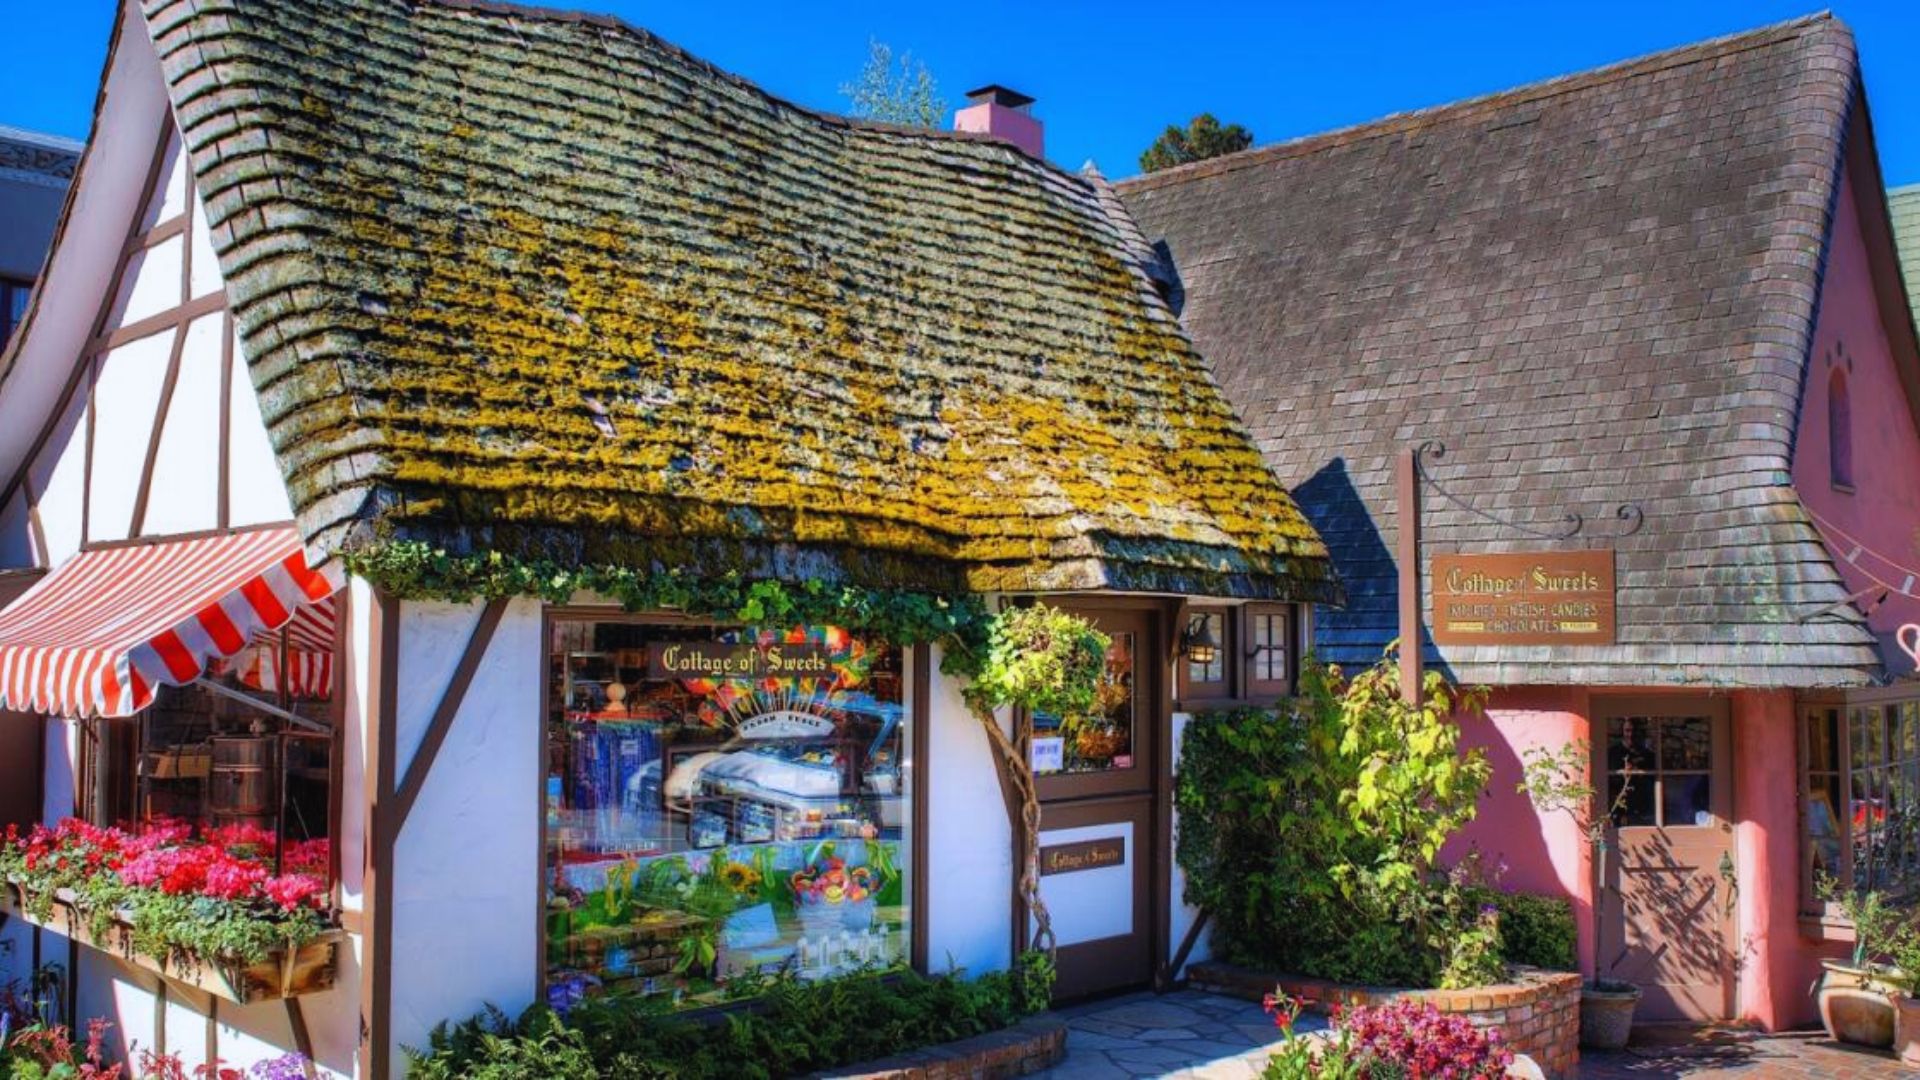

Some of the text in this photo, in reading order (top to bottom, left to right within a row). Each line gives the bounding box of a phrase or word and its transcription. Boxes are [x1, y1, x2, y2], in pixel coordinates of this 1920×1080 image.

[1446, 566, 1513, 598] Cottage
[1532, 566, 1599, 592] Sweets
[1502, 603, 1545, 617] ENGLISH
[1550, 602, 1598, 617] CANDIES
[1487, 619, 1559, 633] CHOCOLATES
[662, 644, 826, 675] Cottage of Sweets
